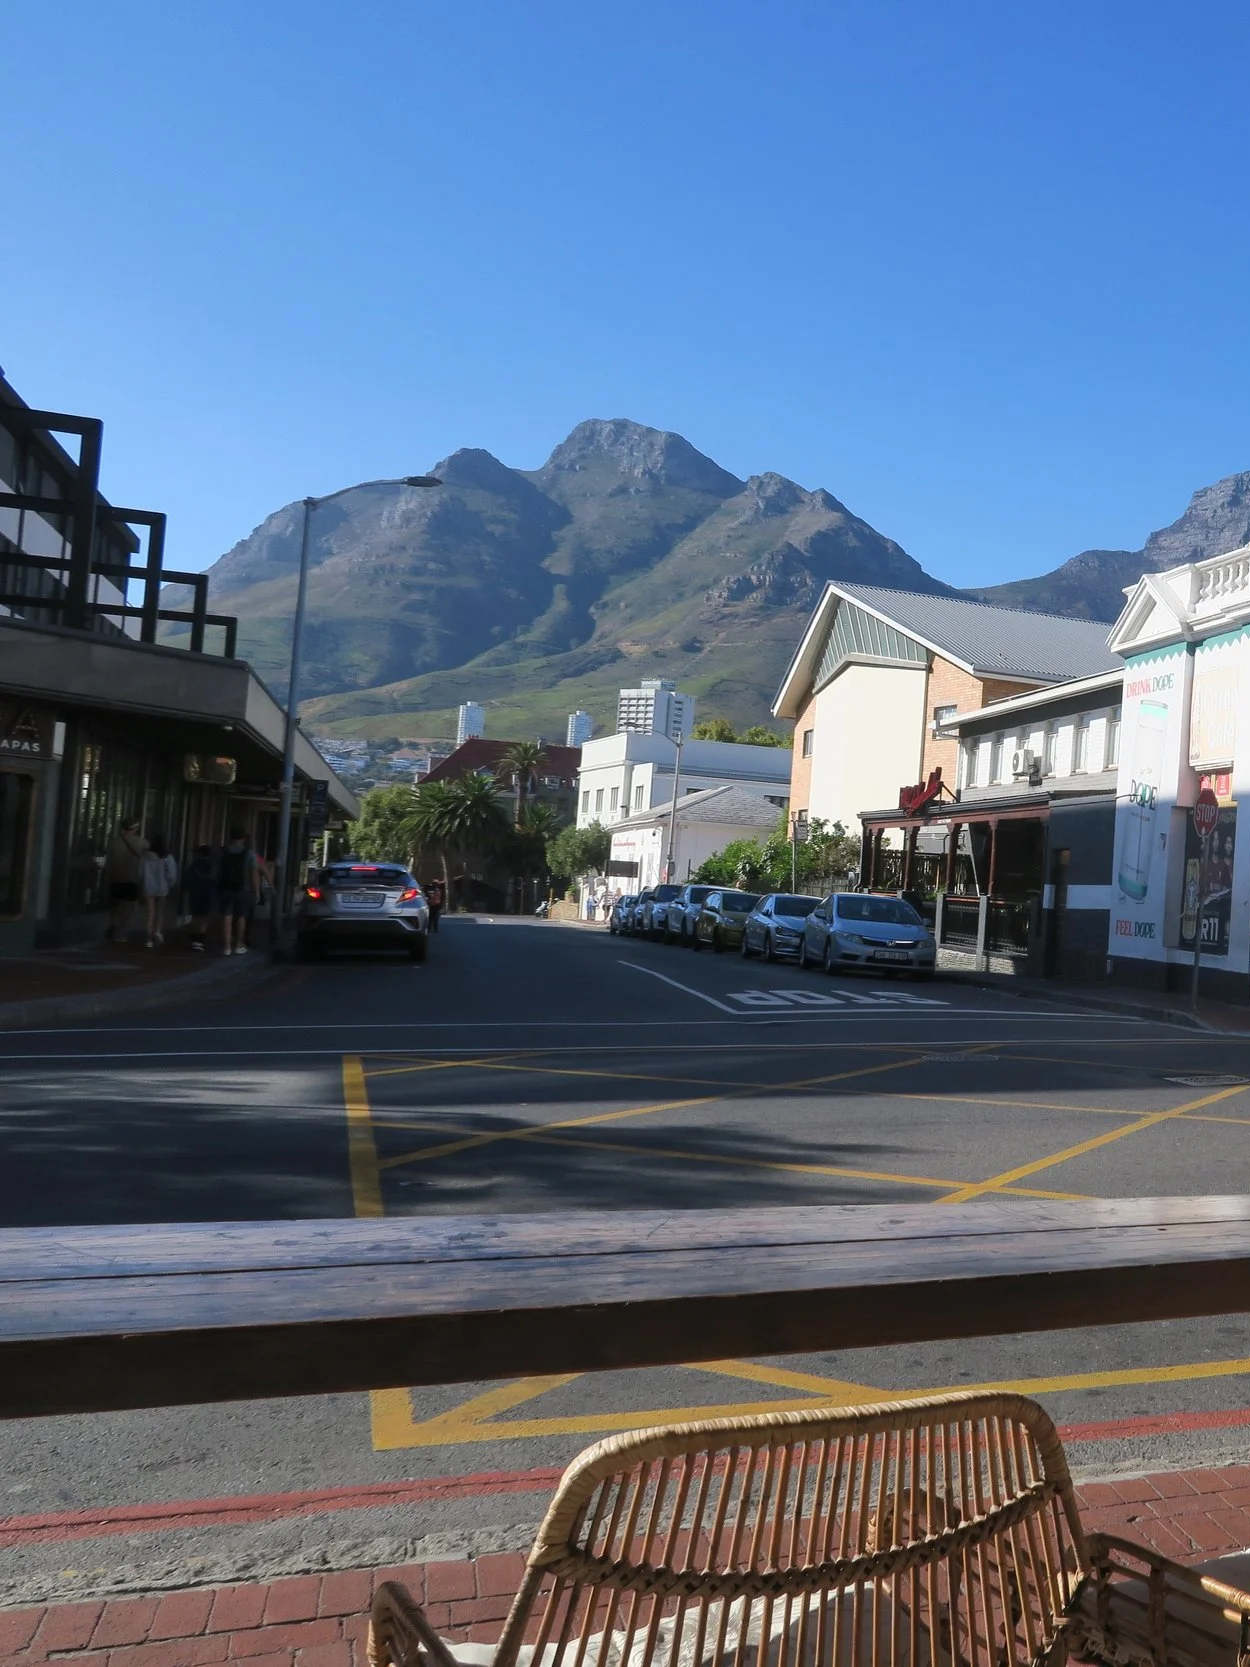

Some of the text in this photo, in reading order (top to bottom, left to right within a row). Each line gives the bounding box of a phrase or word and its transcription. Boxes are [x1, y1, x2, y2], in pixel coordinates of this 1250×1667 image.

[1126, 673, 1175, 698] DRINK DOPE
[1130, 779, 1158, 811] DOPE
[1196, 802, 1216, 824] STOP
[1115, 919, 1155, 939] FEEL DOPE
